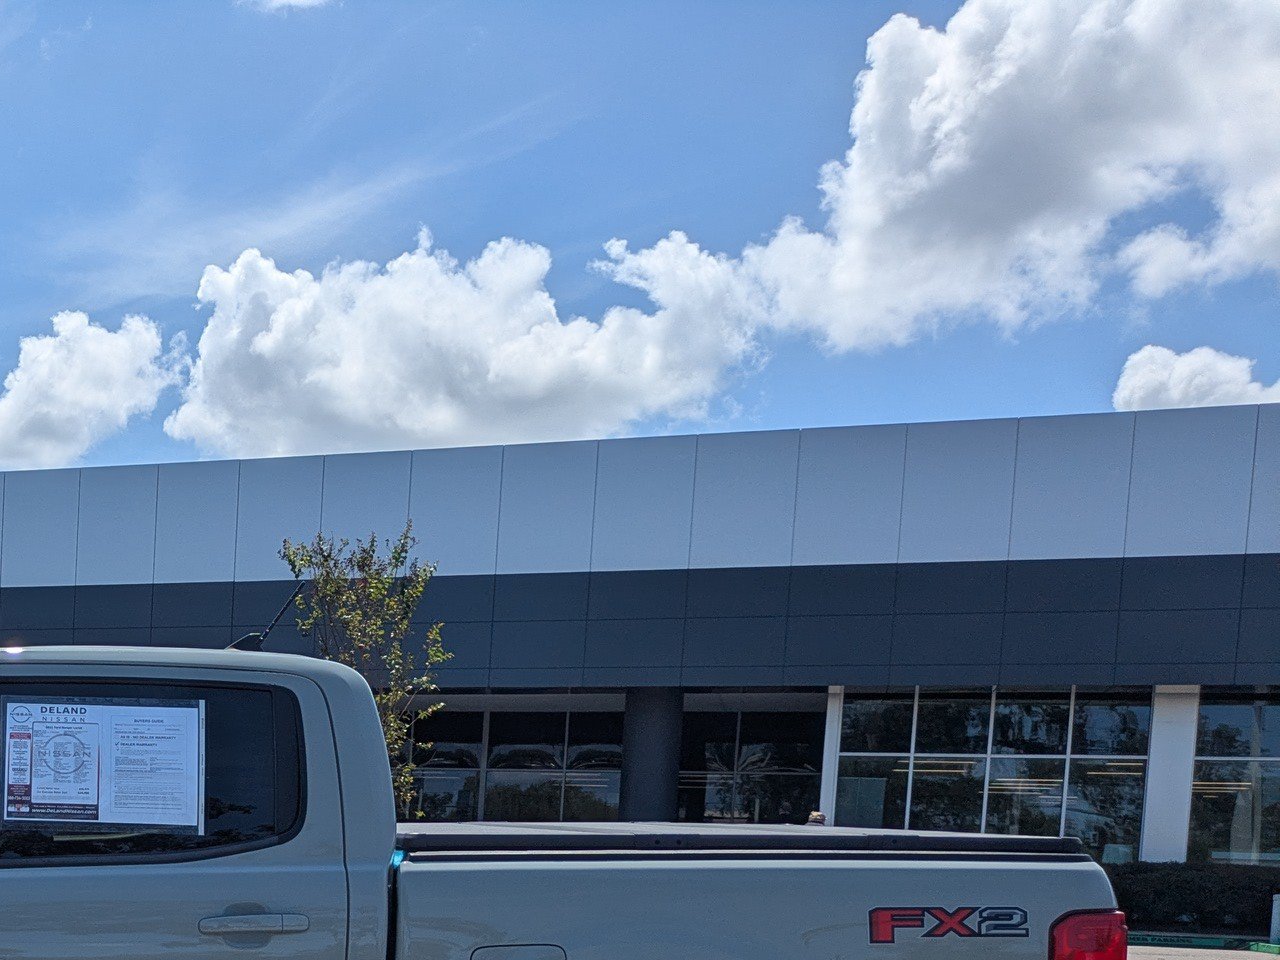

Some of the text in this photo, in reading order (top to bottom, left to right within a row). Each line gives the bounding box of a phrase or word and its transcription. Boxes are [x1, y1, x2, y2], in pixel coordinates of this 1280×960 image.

[40, 706, 87, 715] DELAND
[37, 750, 91, 758] NISSAN
[868, 906, 1030, 944] FX2
[1150, 936, 1193, 944] PARKING
